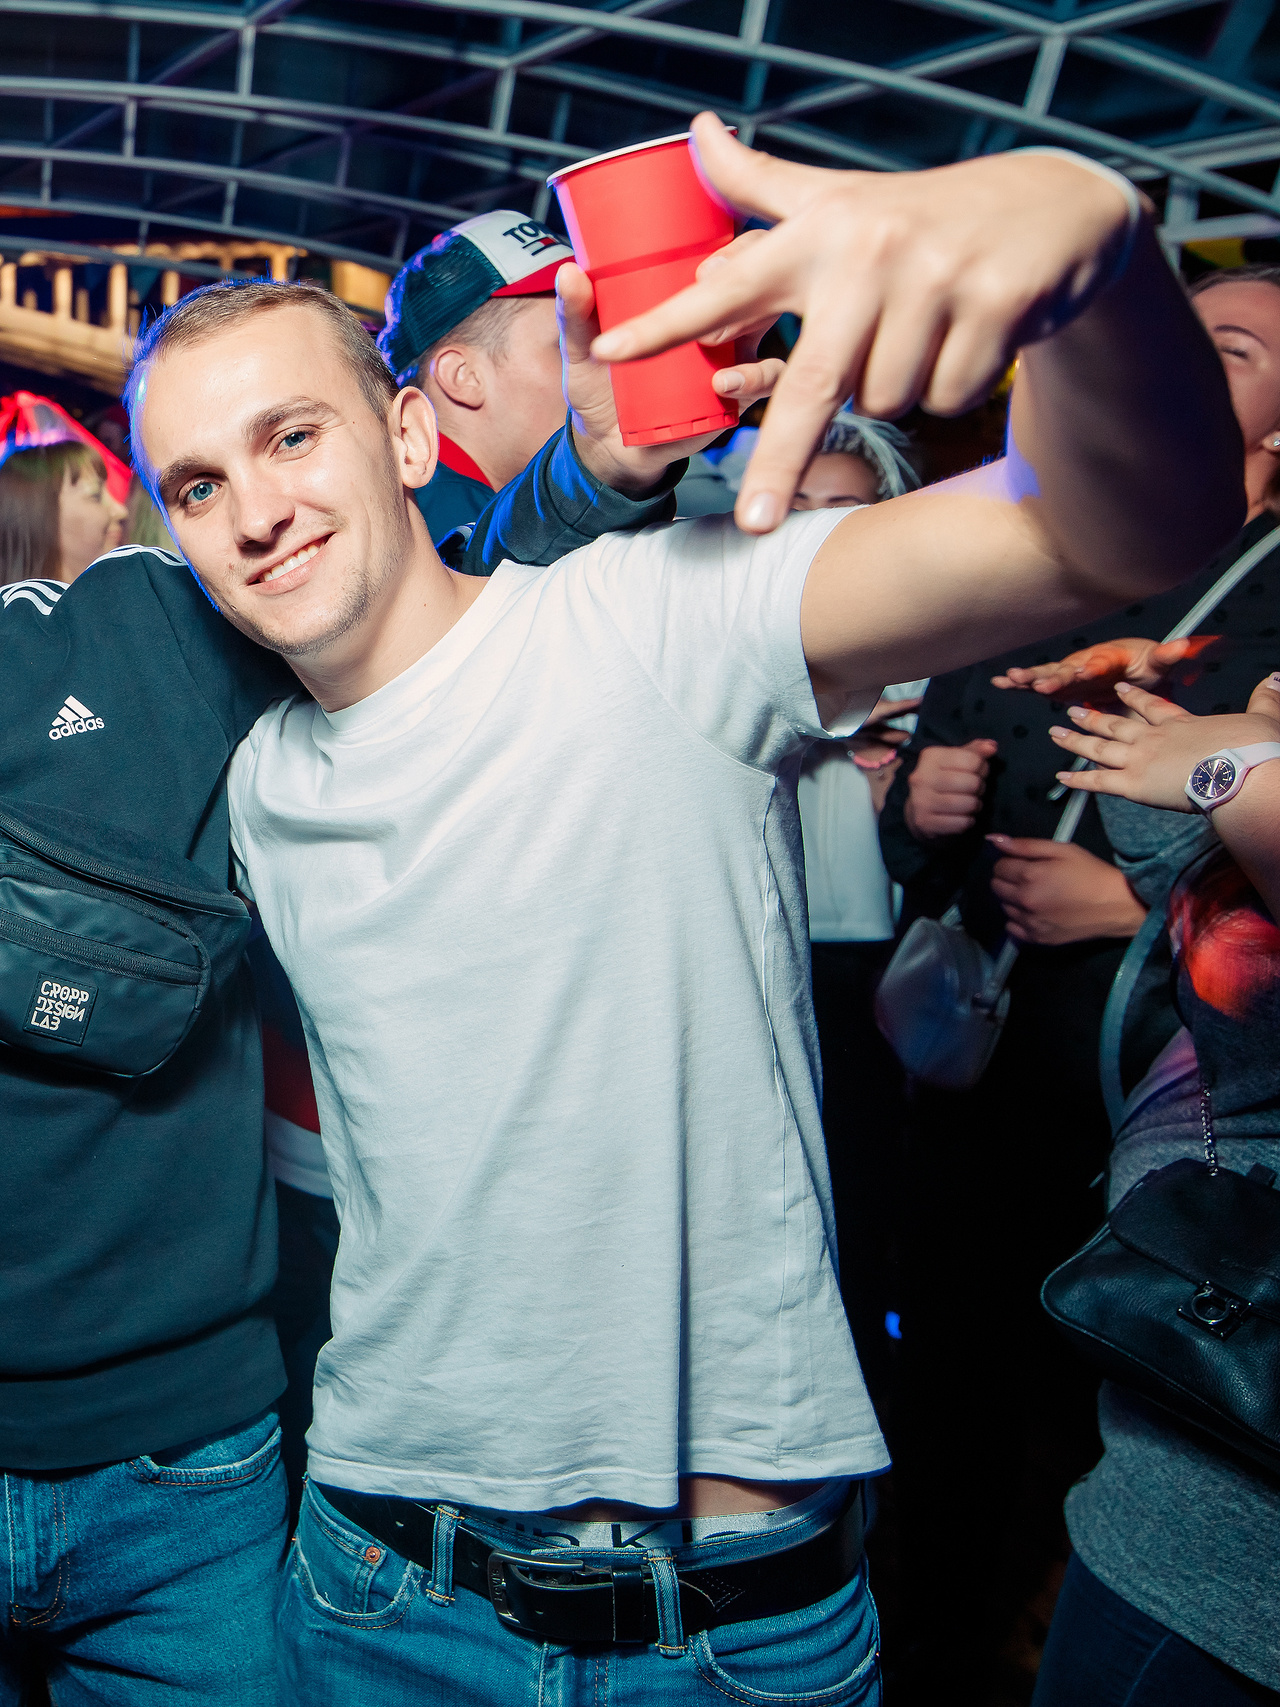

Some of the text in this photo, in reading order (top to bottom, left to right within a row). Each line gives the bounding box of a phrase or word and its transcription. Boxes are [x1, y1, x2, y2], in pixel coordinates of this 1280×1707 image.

[503, 221, 551, 243] TO
[48, 717, 105, 741] adidas
[40, 980, 90, 1005] CROPP
[30, 1010, 61, 1031] LAB
[34, 996, 86, 1022] DESIGN
